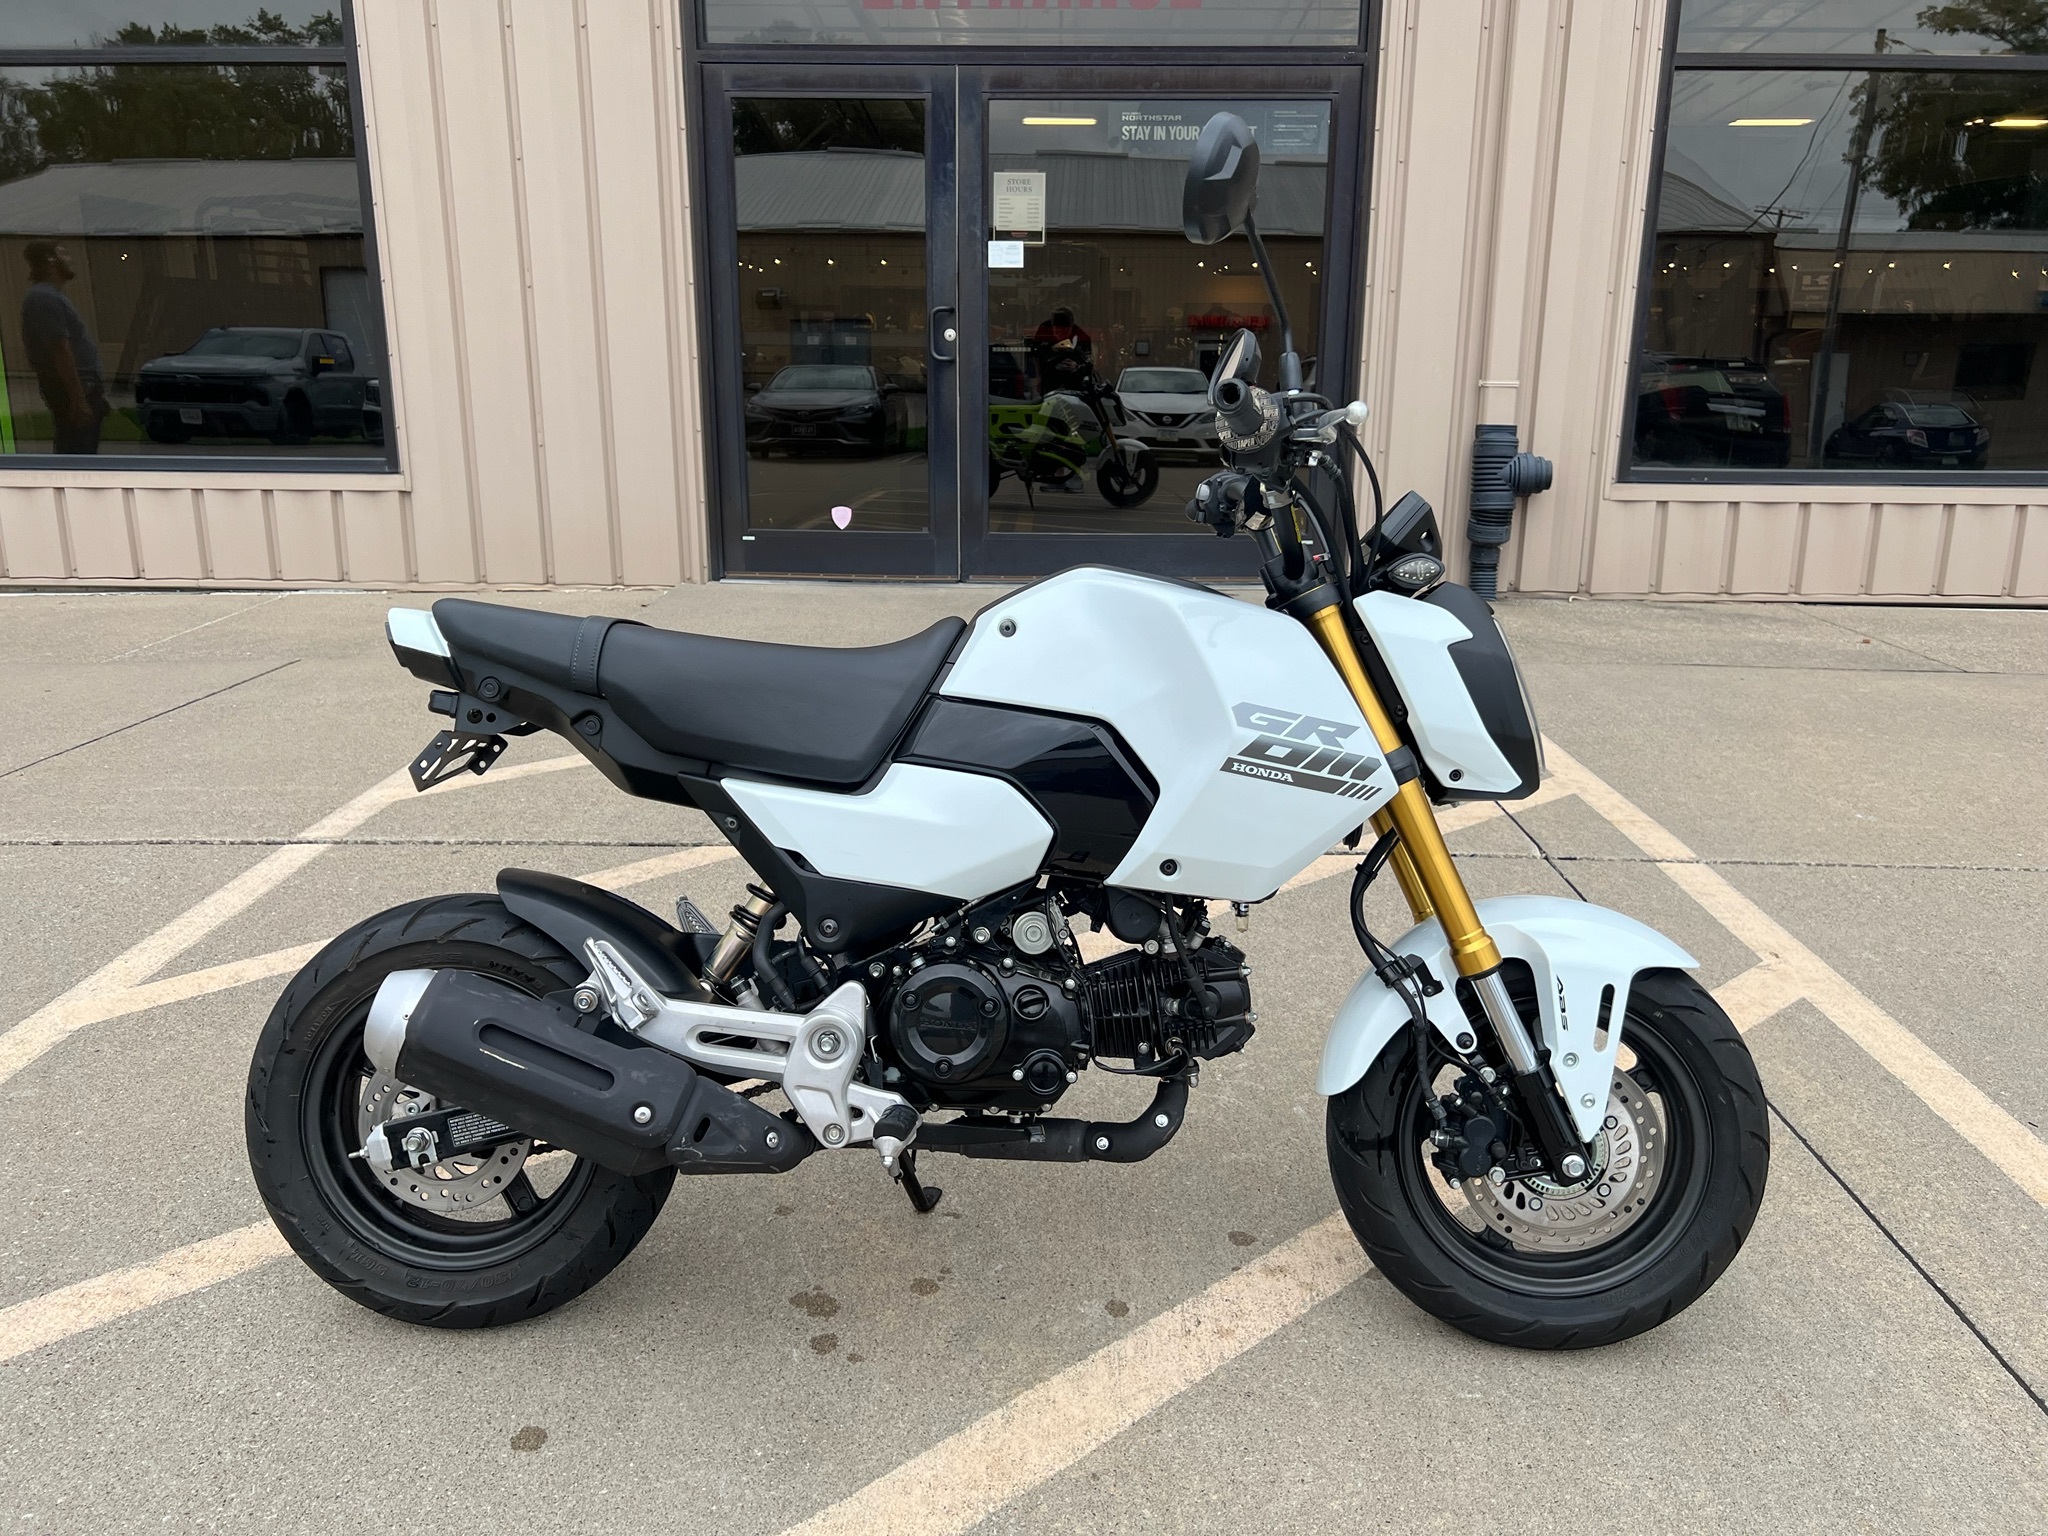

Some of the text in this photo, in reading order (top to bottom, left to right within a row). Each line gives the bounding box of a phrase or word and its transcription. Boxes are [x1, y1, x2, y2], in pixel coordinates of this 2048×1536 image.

[1121, 125, 1151, 141] STAY
[1153, 125, 1166, 141] IN
[1168, 125, 1200, 141] YOUR
[1231, 762, 1294, 783] HONDA
[1556, 974, 1569, 1031] ABS
